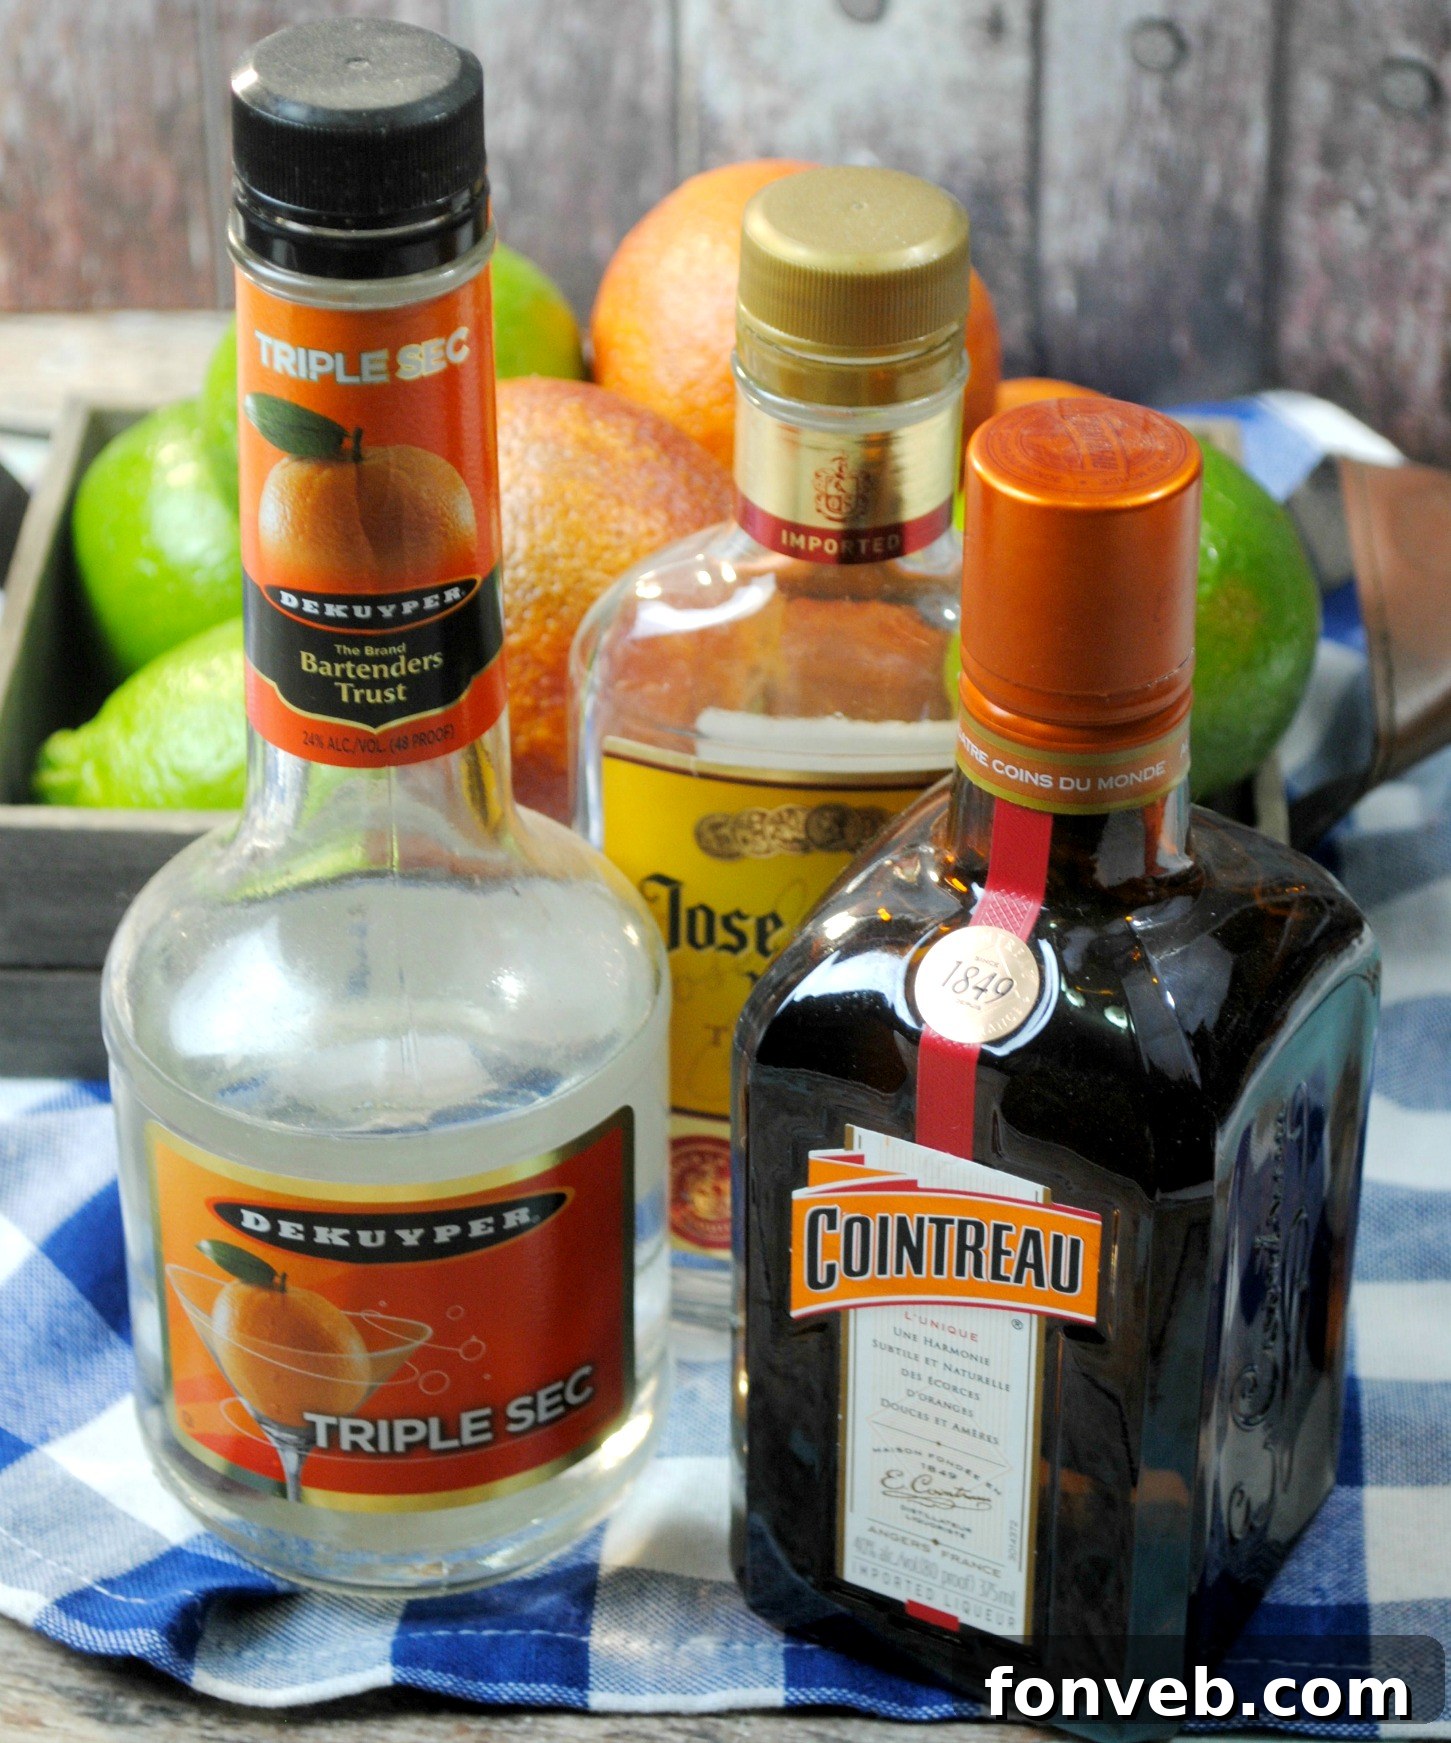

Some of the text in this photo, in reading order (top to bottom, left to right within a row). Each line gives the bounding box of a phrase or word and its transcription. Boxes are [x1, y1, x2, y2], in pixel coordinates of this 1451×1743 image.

[254, 327, 470, 384] TRIPLE SEC
[781, 529, 900, 555] IMPORTED
[279, 587, 464, 619] DEKUYPER
[300, 651, 443, 679] Bartenders
[334, 643, 406, 657] The Brand
[334, 682, 407, 704] Trust
[303, 731, 323, 748] 24%
[412, 724, 455, 747] PROOF)
[992, 759, 1053, 788] COINS
[1059, 776, 1091, 791] DU
[1097, 760, 1167, 790] MONDE
[638, 873, 784, 958] Jose
[942, 960, 1014, 1004] 1849
[240, 1206, 532, 1248] DEKUYPER
[805, 1205, 1085, 1295] COINTREAU
[904, 1311, 978, 1342] L'UNIQUE
[893, 1326, 991, 1366] UNE HARMONIE
[872, 1339, 1011, 1392] SUBTILE ET NATURELLE
[901, 1368, 922, 1381] DES
[303, 1364, 595, 1453] TRIPLE SEC
[881, 1398, 930, 1421] DOUCES
[935, 1416, 948, 1427] ET
[868, 1526, 1001, 1578] ANGERS FRANCE
[851, 1561, 935, 1601] IMPORTED
